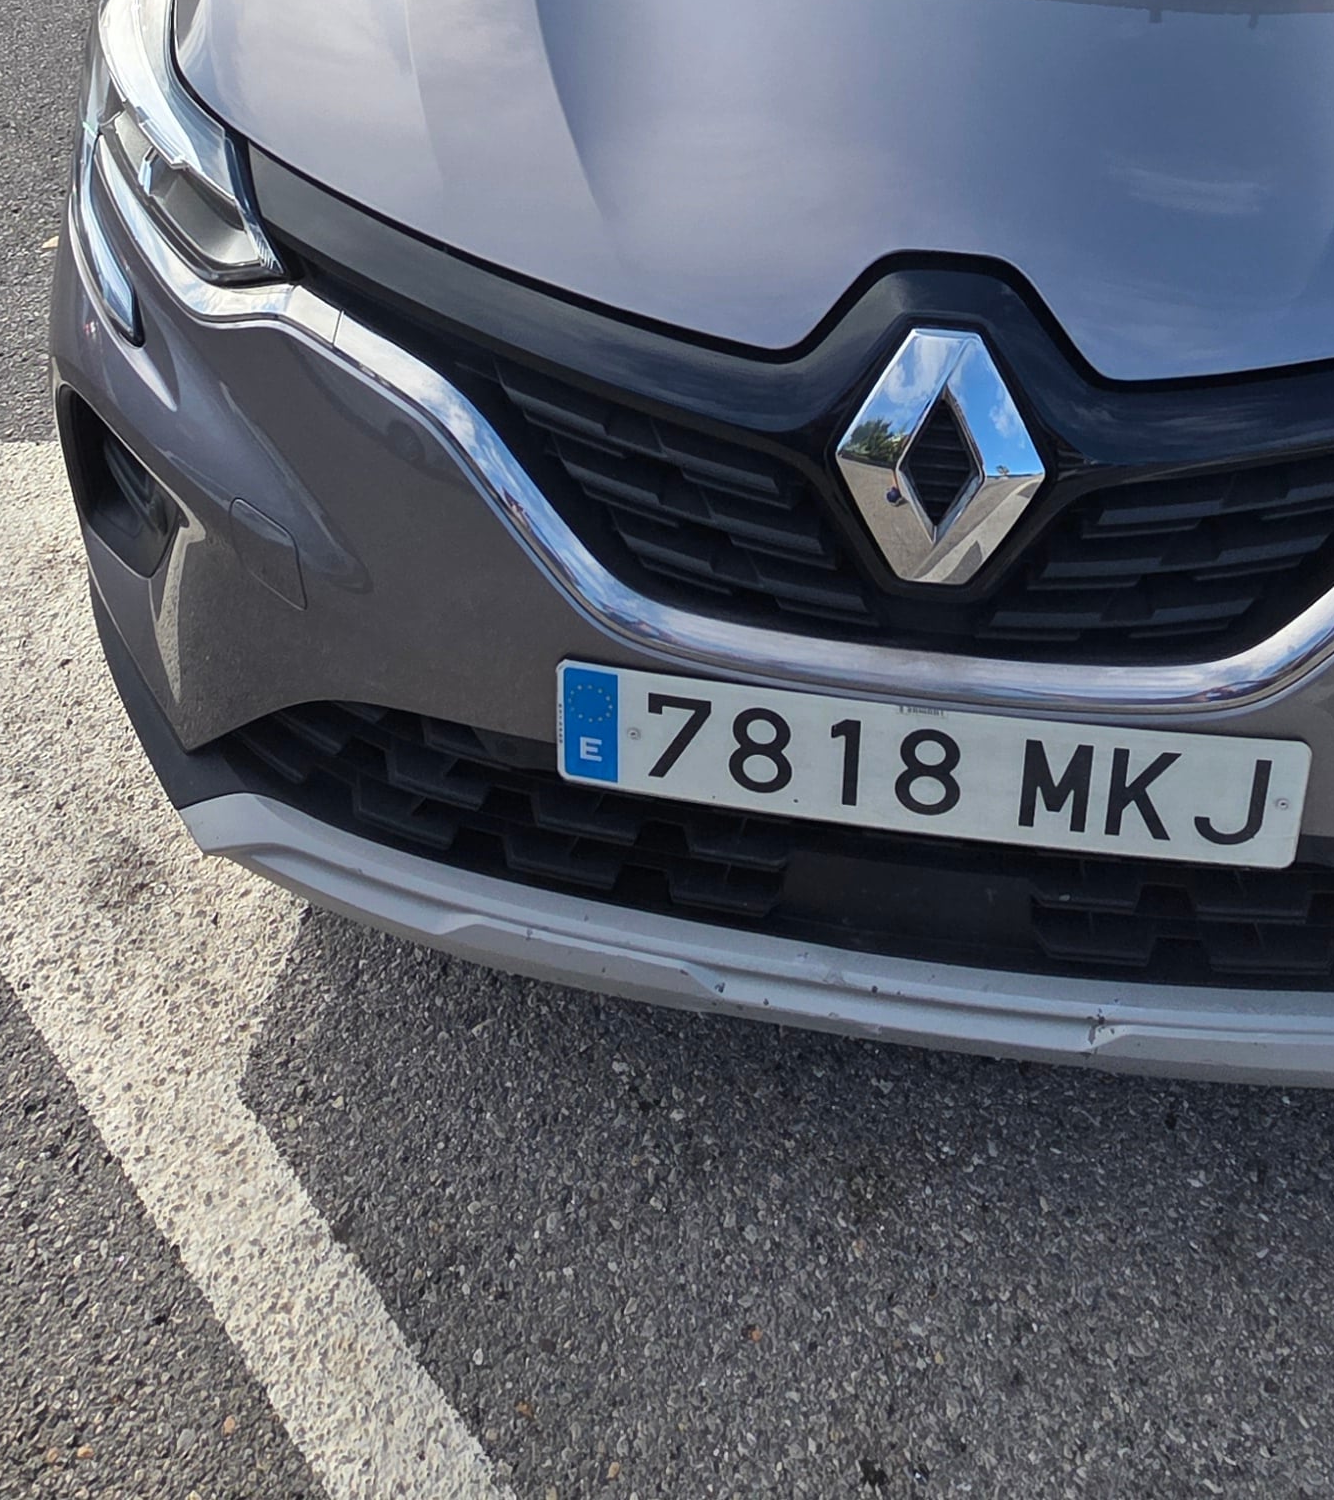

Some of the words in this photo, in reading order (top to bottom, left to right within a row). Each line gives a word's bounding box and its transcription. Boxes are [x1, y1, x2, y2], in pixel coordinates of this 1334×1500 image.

[579, 735, 603, 762] E
[646, 691, 962, 816] 7818
[1017, 738, 1274, 845] MKJ
